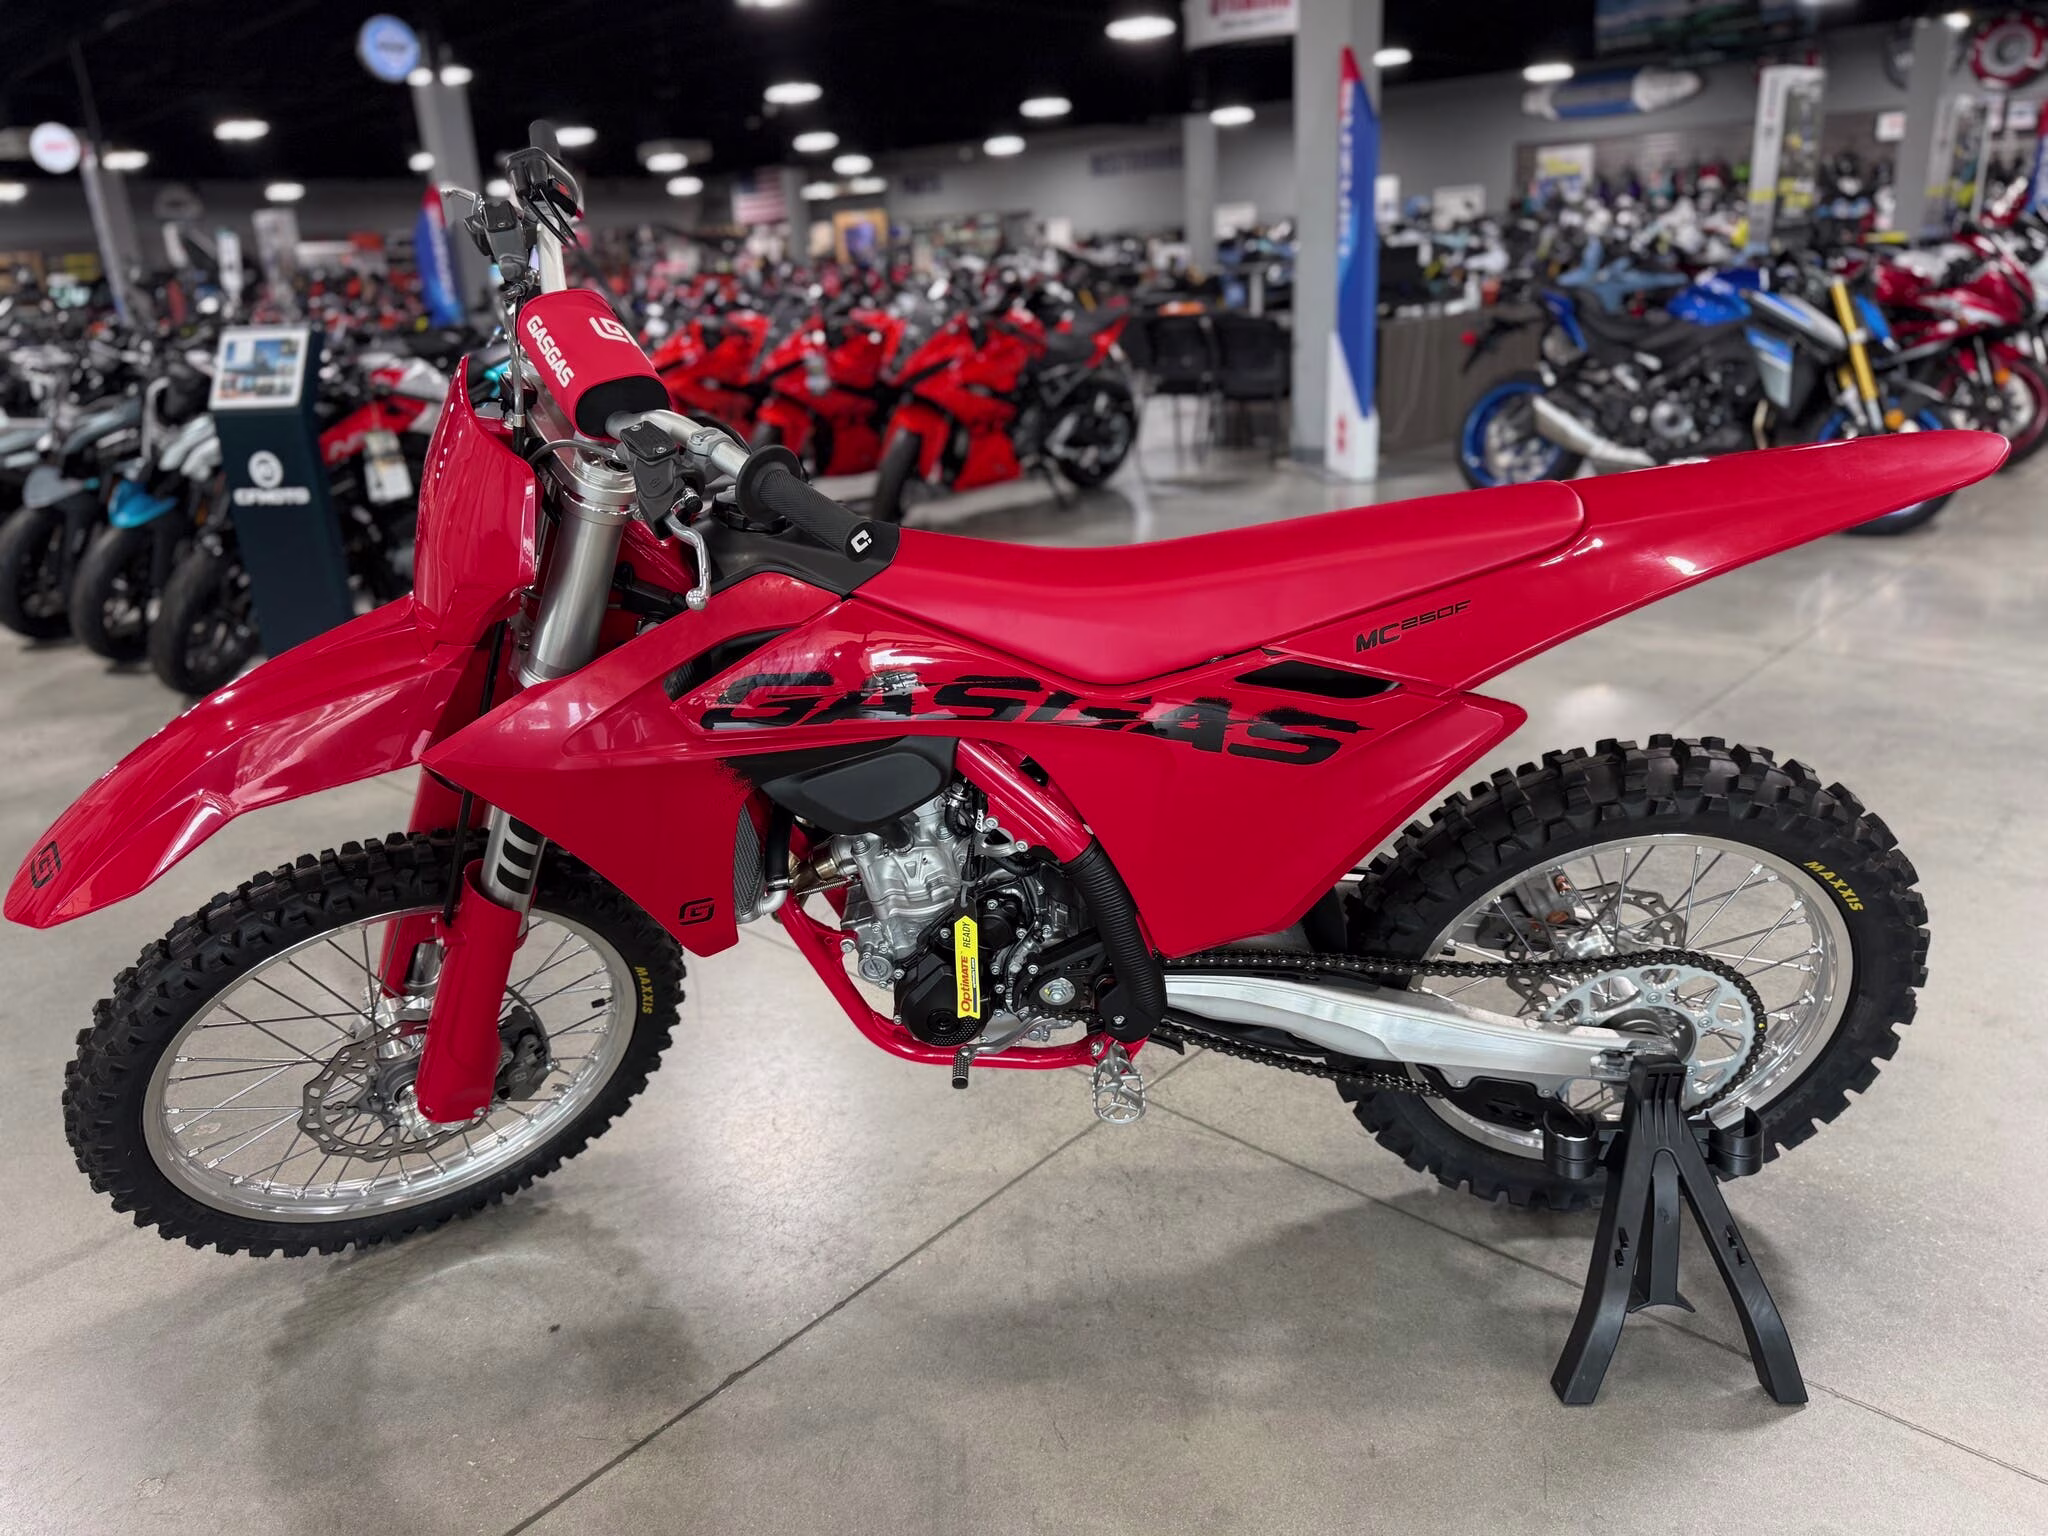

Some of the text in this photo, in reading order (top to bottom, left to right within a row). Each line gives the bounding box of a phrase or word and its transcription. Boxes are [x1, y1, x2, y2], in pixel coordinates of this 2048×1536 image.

[526, 315, 575, 389] GASGAS
[701, 671, 1372, 765] GASGAS
[1803, 861, 1864, 910] MAXXIS
[961, 921, 971, 948] READY
[634, 966, 654, 1014] MAXXIS
